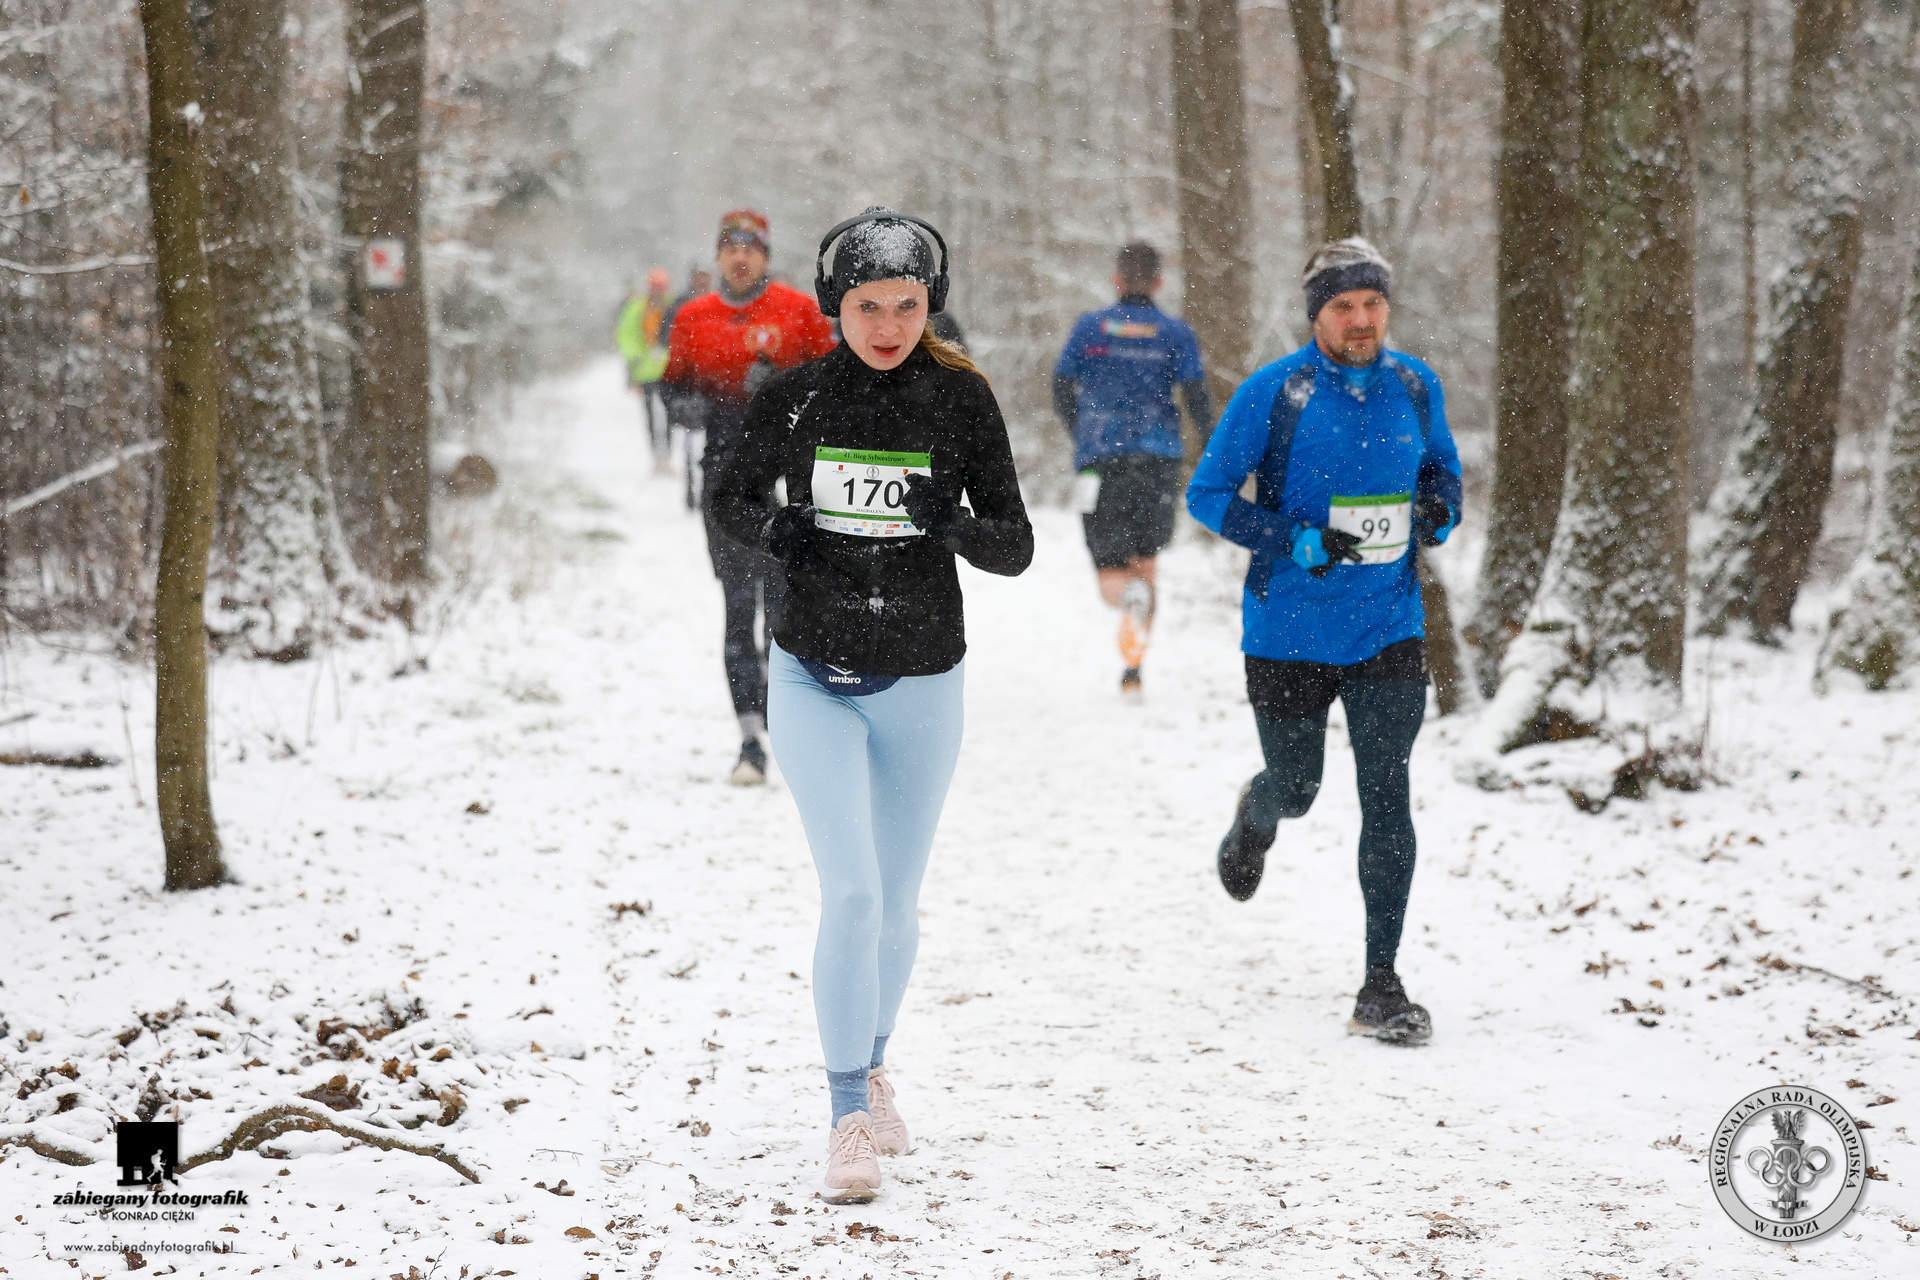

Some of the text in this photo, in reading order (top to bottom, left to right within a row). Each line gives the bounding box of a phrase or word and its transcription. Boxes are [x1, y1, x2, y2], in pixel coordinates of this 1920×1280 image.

[843, 478, 904, 509] 170
[1362, 518, 1390, 541] 99
[828, 675, 861, 684] umbro
